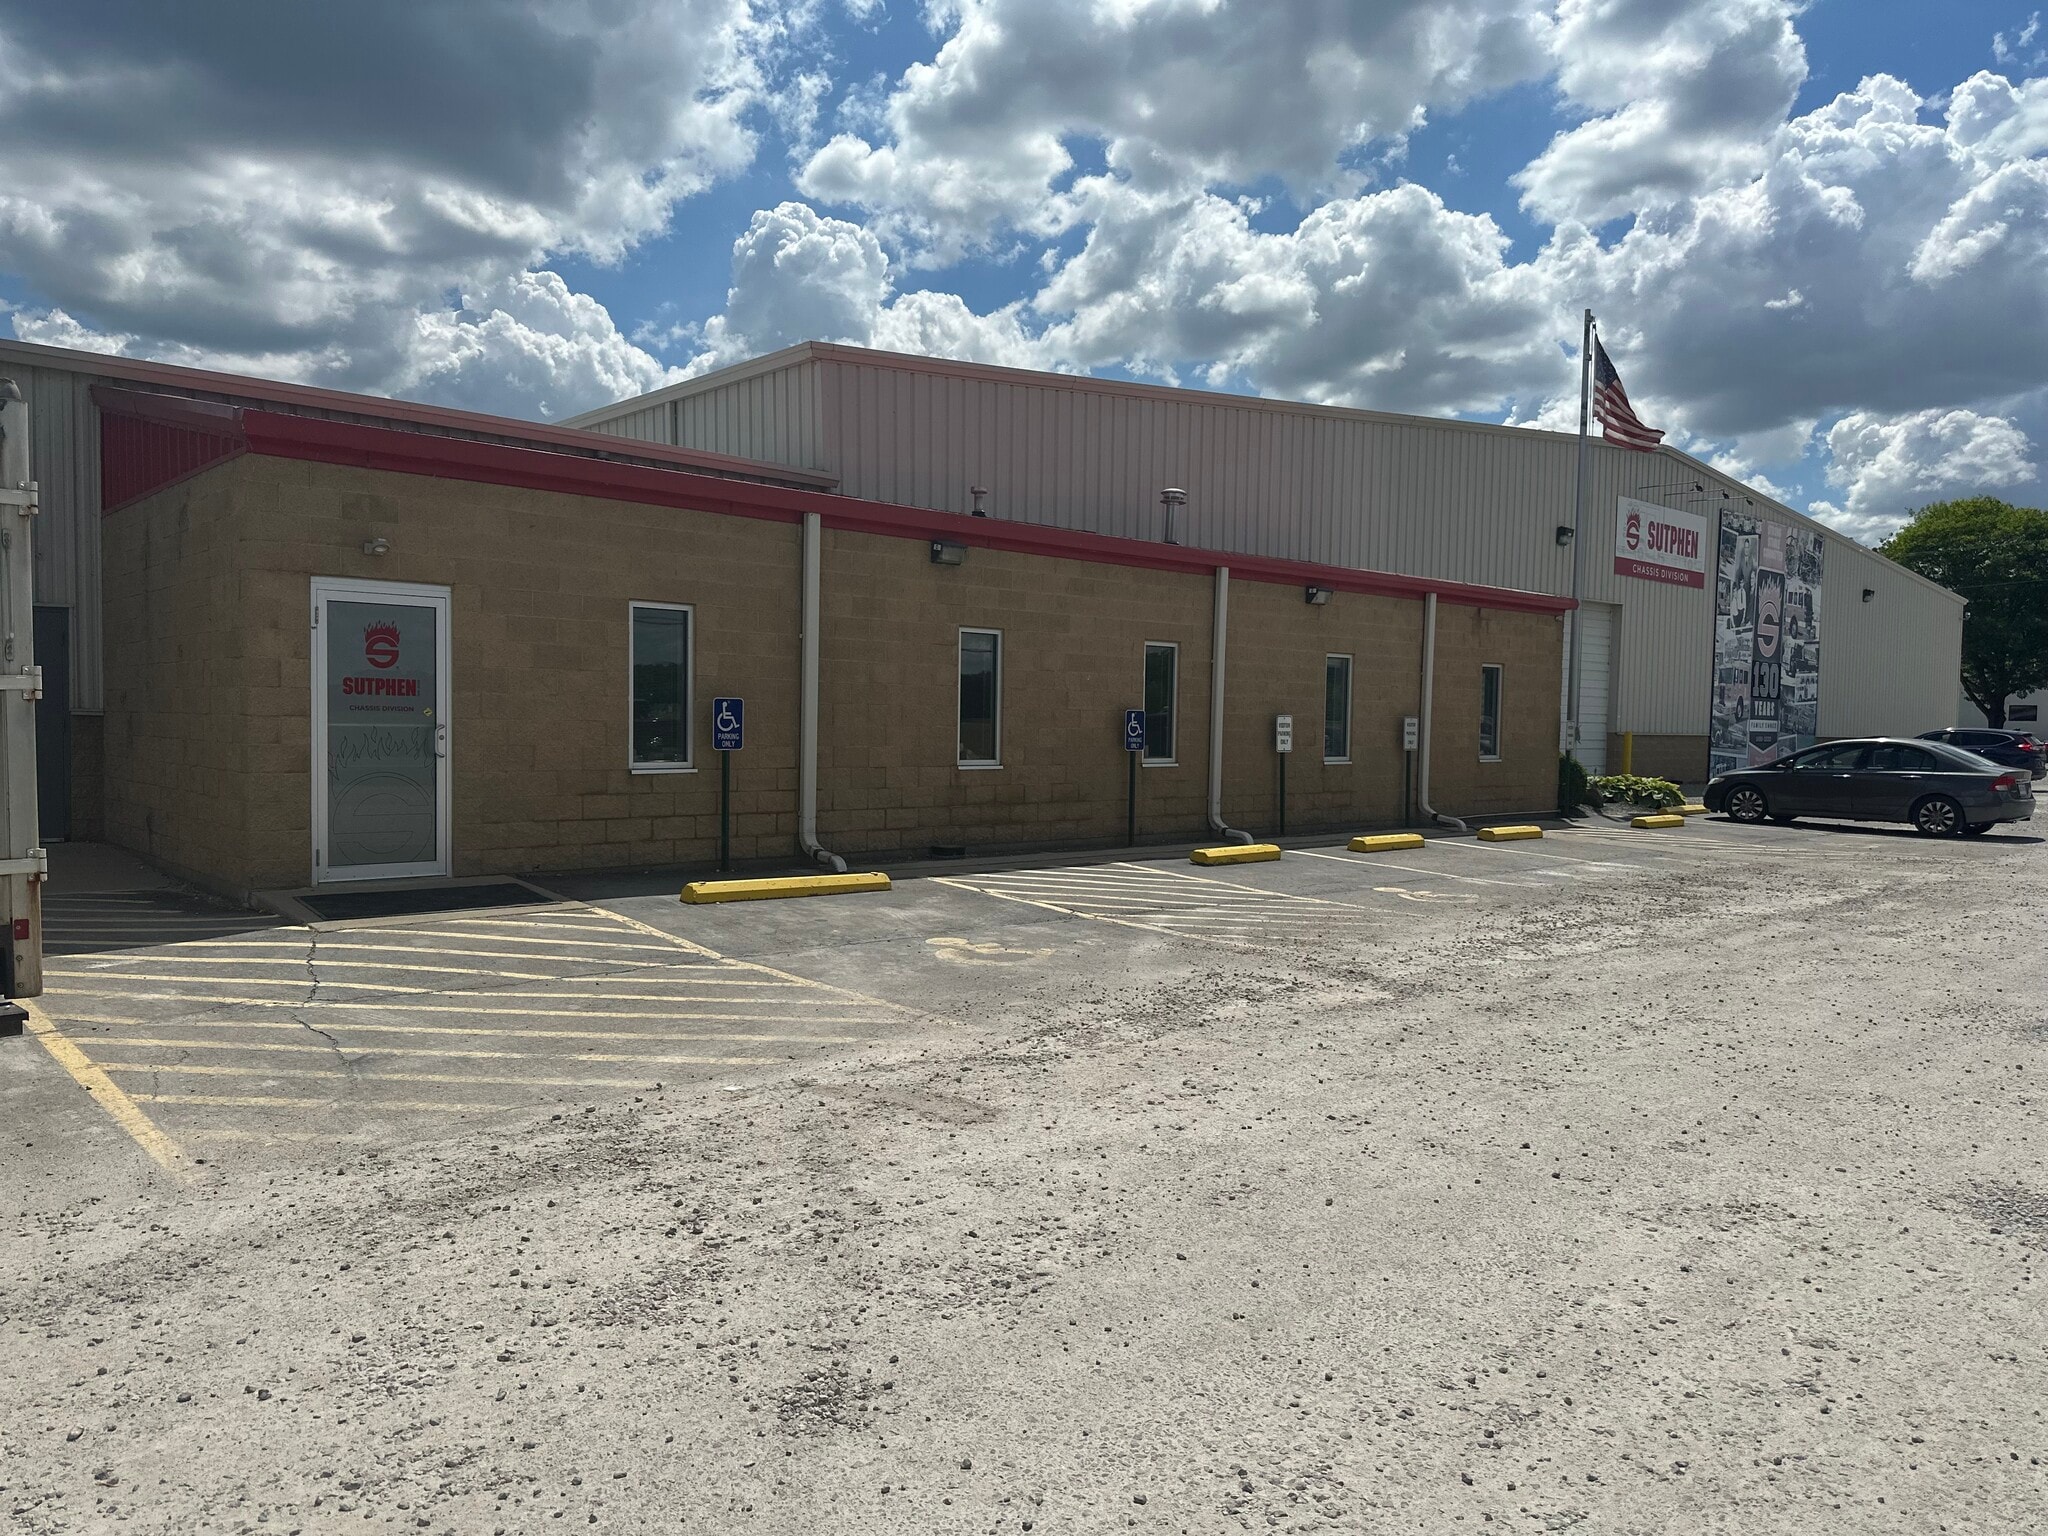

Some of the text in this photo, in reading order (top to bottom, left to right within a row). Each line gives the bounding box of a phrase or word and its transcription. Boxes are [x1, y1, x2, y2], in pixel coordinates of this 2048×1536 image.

[1647, 521, 1699, 559] SUTPHEN
[1632, 564, 1689, 582] CHASSIS DIVISION
[342, 676, 417, 697] SUTPHEN
[1752, 661, 1780, 698] 130
[349, 704, 380, 712] CHASSIS
[1754, 700, 1775, 716] YEARS
[717, 732, 740, 740] PARKING
[721, 740, 736, 748] ONLY
